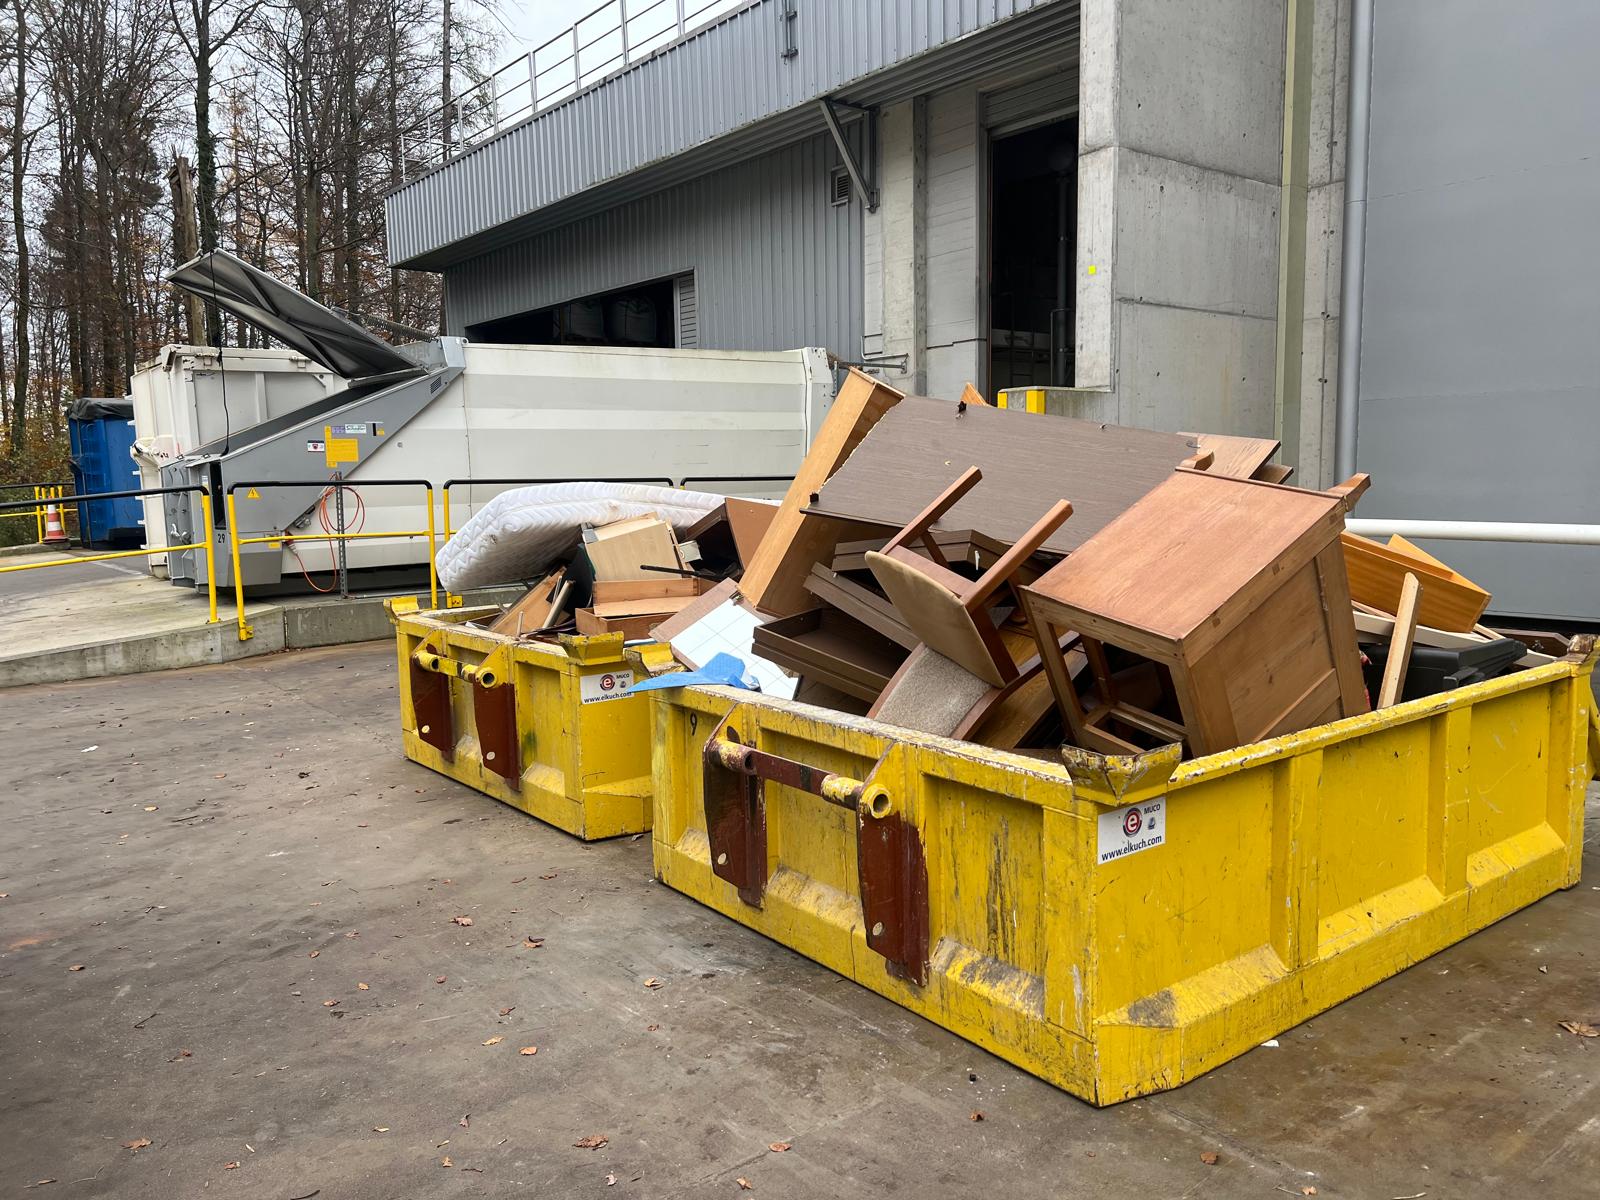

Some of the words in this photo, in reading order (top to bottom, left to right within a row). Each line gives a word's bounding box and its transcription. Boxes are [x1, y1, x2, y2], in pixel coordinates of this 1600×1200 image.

[217, 533, 226, 544] 29
[690, 712, 697, 736] 9
[1143, 803, 1161, 815] MUCO
[1101, 835, 1162, 862] www.elkuch.com
